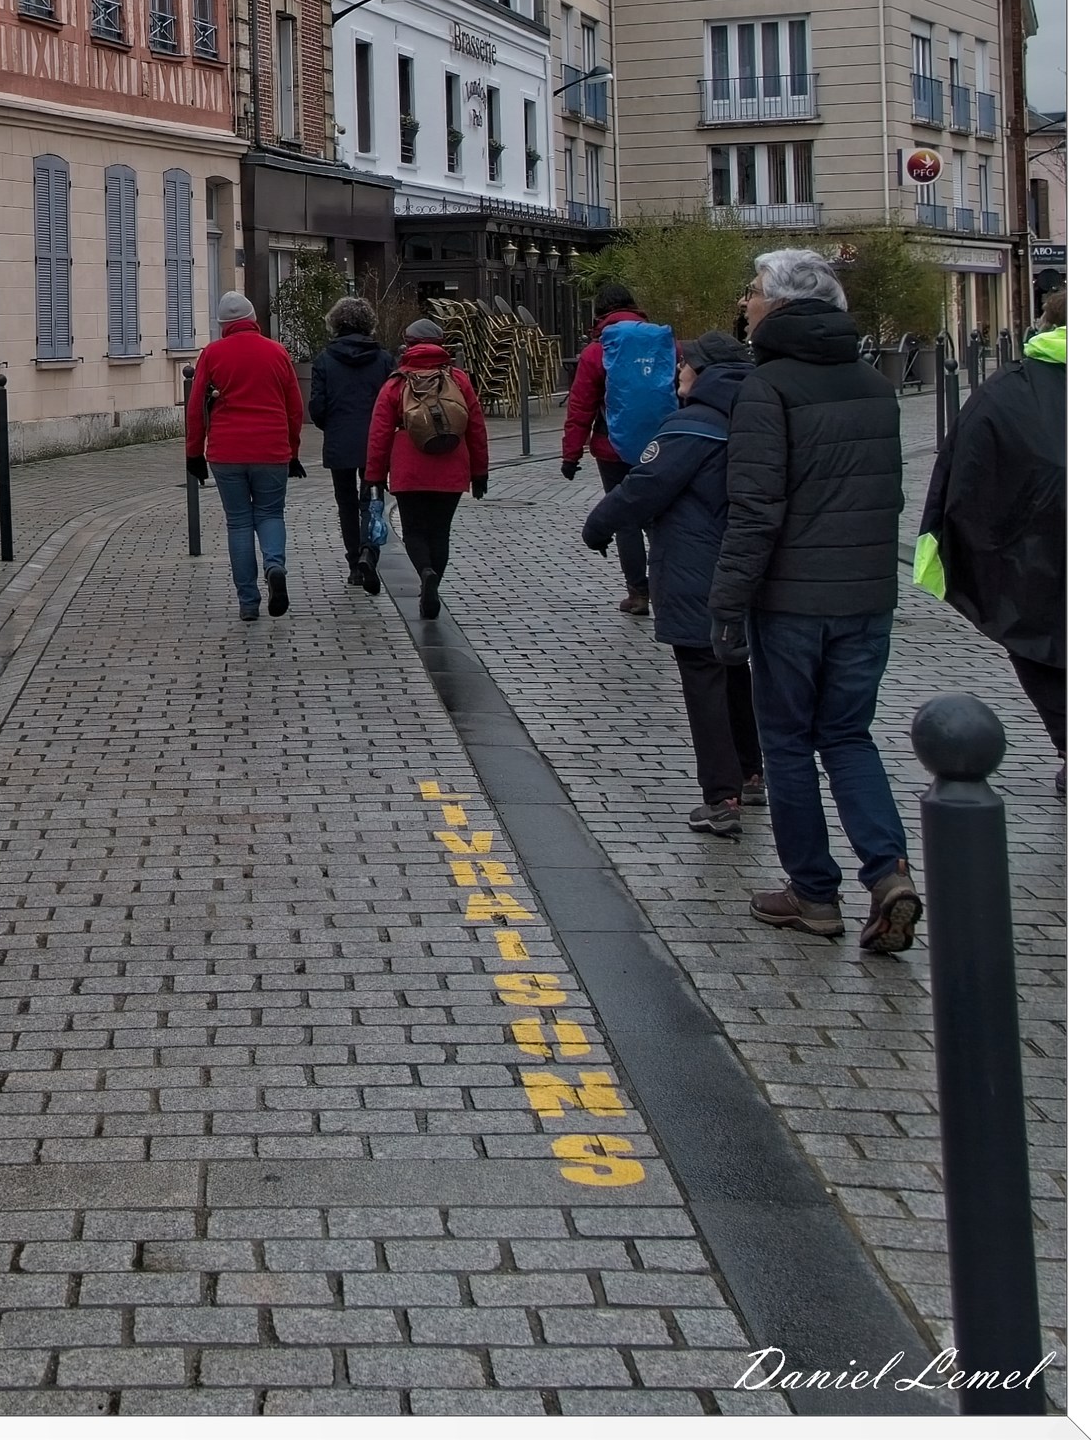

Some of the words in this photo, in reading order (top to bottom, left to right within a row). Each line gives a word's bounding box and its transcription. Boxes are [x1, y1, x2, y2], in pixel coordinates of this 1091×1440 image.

[453, 21, 497, 66] Brasserie
[472, 108, 483, 128] Pub
[913, 168, 935, 177] PFG
[418, 780, 646, 1187] LIVRAISONS
